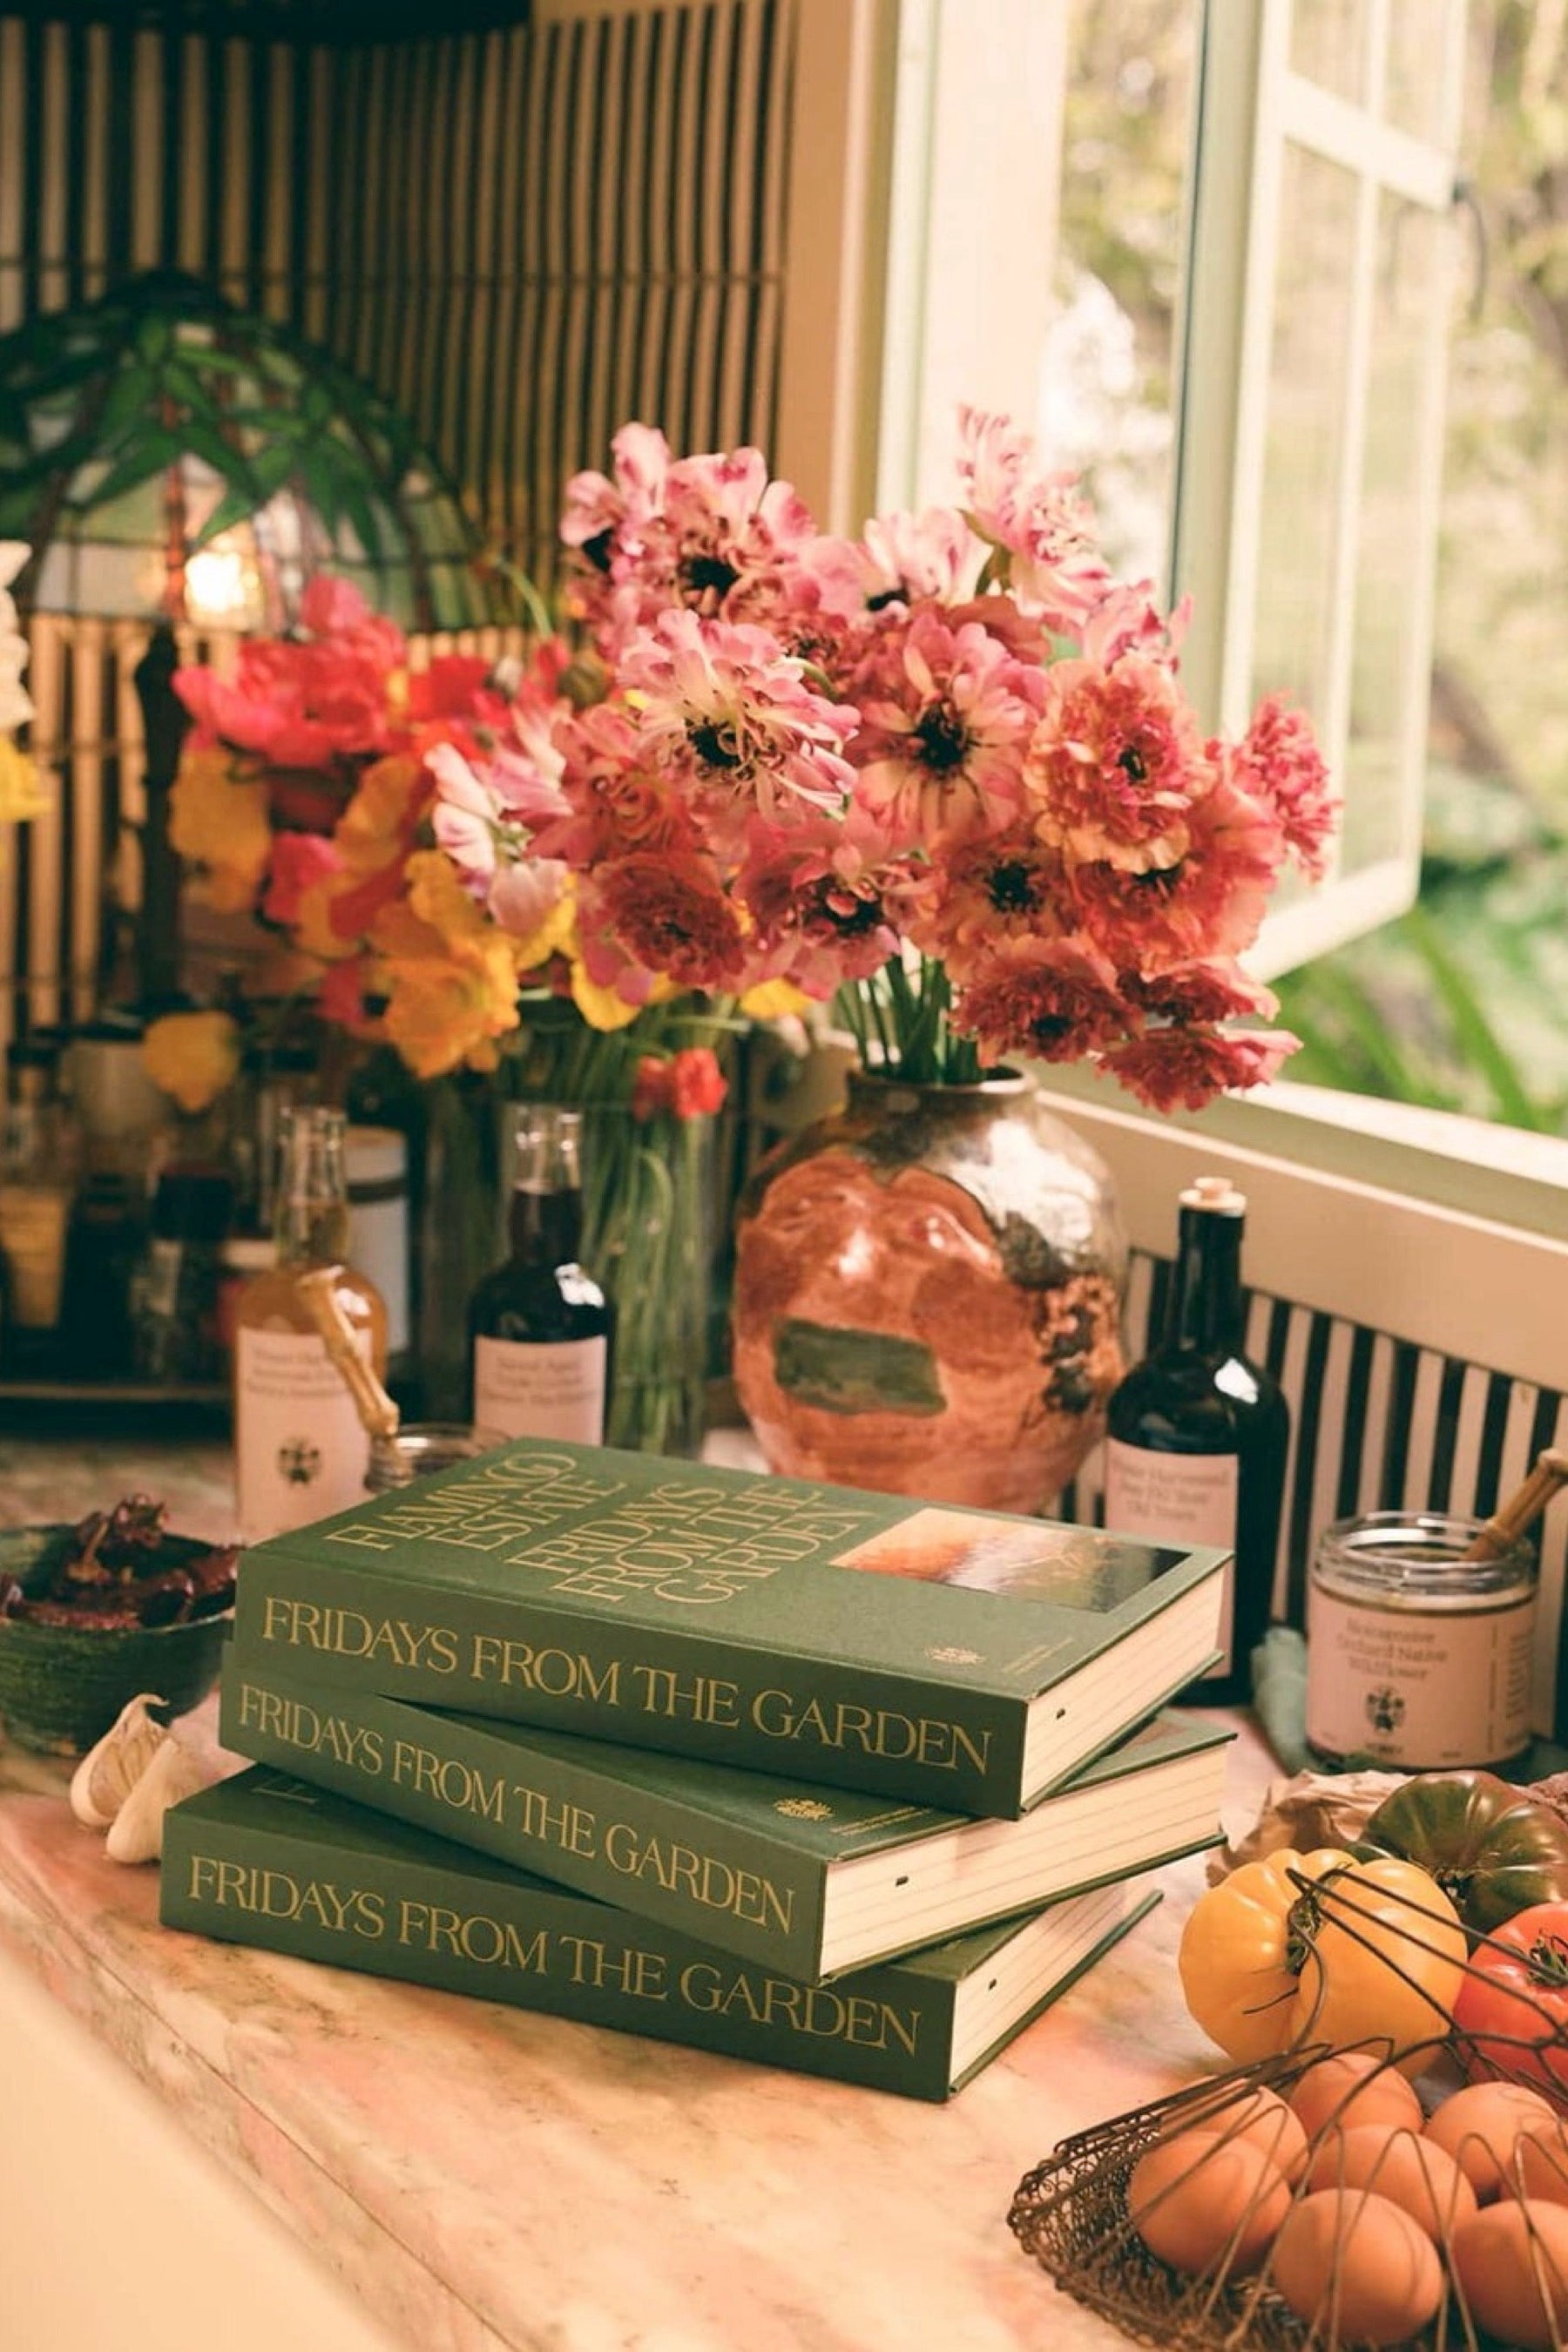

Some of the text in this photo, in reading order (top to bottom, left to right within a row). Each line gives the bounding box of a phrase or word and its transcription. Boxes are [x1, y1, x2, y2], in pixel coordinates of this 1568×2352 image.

[324, 1452, 577, 1551] FLAMINGO
[428, 1475, 627, 1551] ESTATE
[504, 1483, 727, 1574] FRIDAYS
[551, 1484, 824, 1602] FROM THE
[653, 1502, 876, 1604] GARDEN
[262, 1598, 992, 1776] FRIDAYS FROM THE GARDEN
[239, 1684, 795, 1935] FRIDAYS FROM THE GARDEN
[188, 1855, 921, 2057] FRIDAYS FROM THE GARDEN
